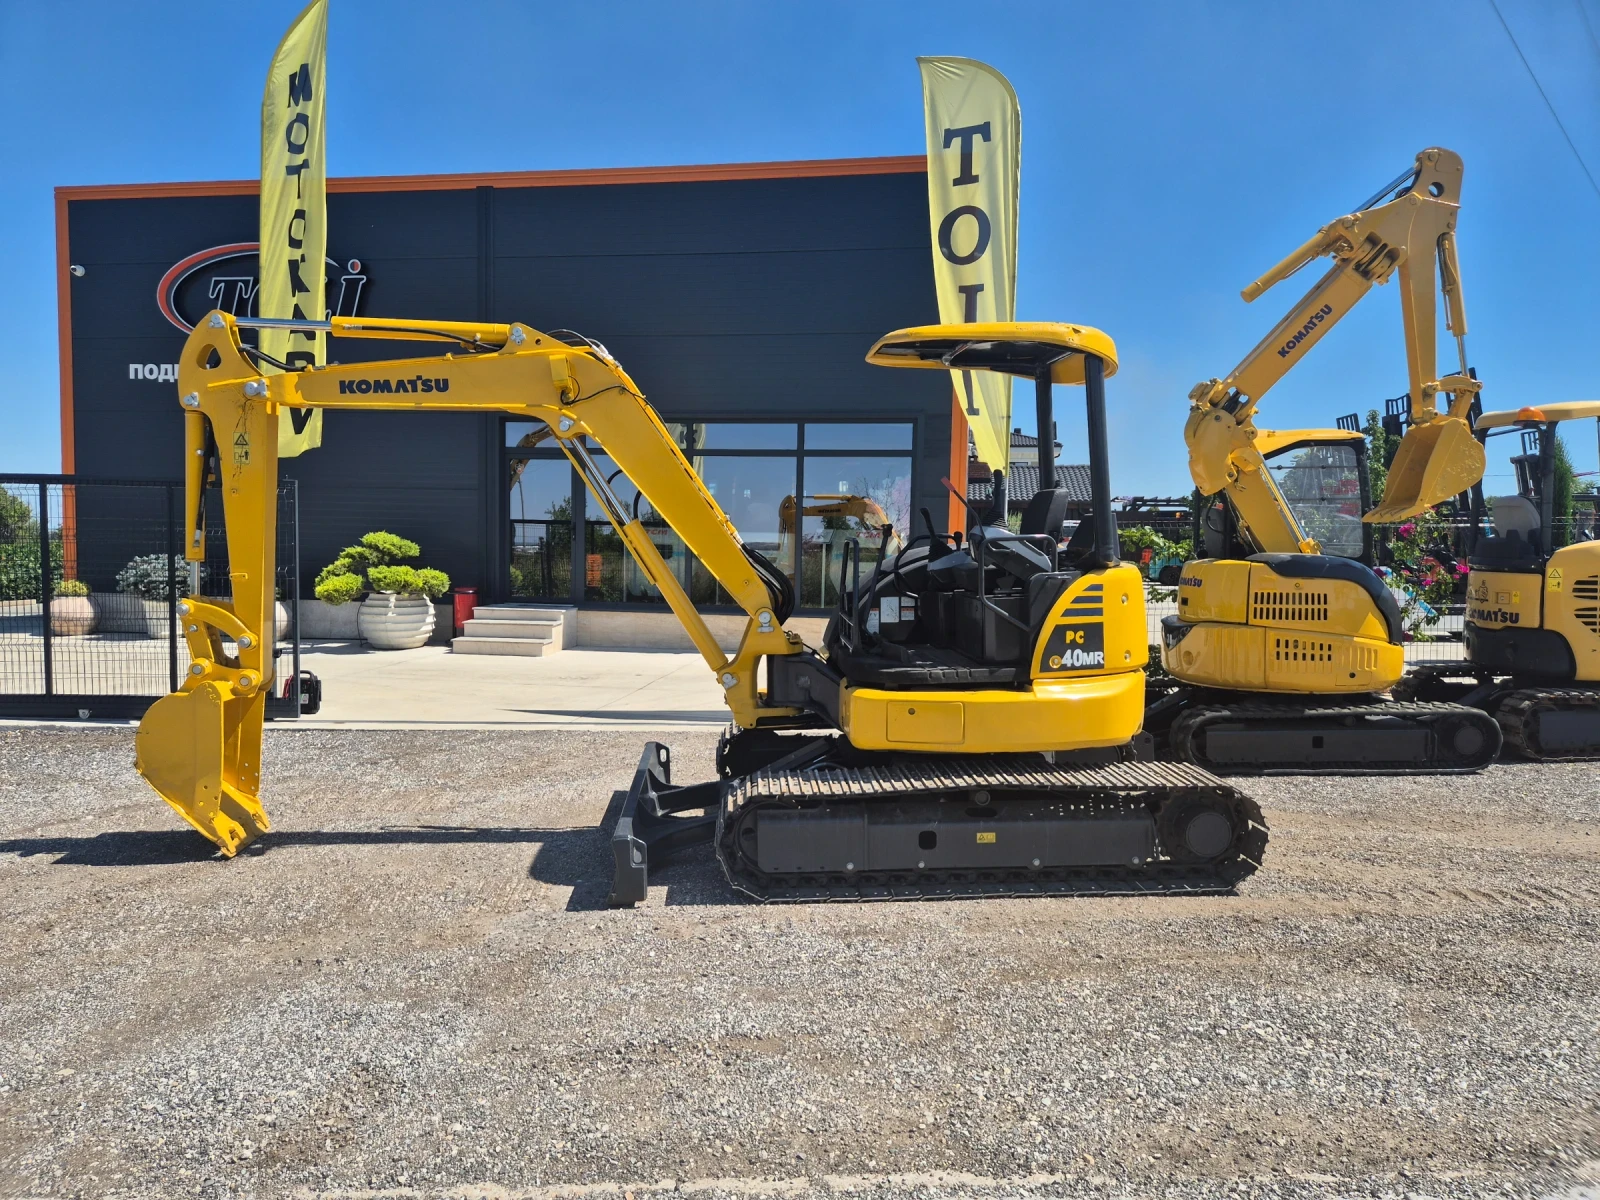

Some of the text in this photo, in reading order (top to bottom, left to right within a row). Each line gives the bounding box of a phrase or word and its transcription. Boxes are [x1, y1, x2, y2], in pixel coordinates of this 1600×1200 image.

[1277, 303, 1333, 358] KOMATSU
[338, 375, 450, 394] KOMATSU
[1065, 630, 1085, 644] PC
[1061, 648, 1105, 668] 40MR
